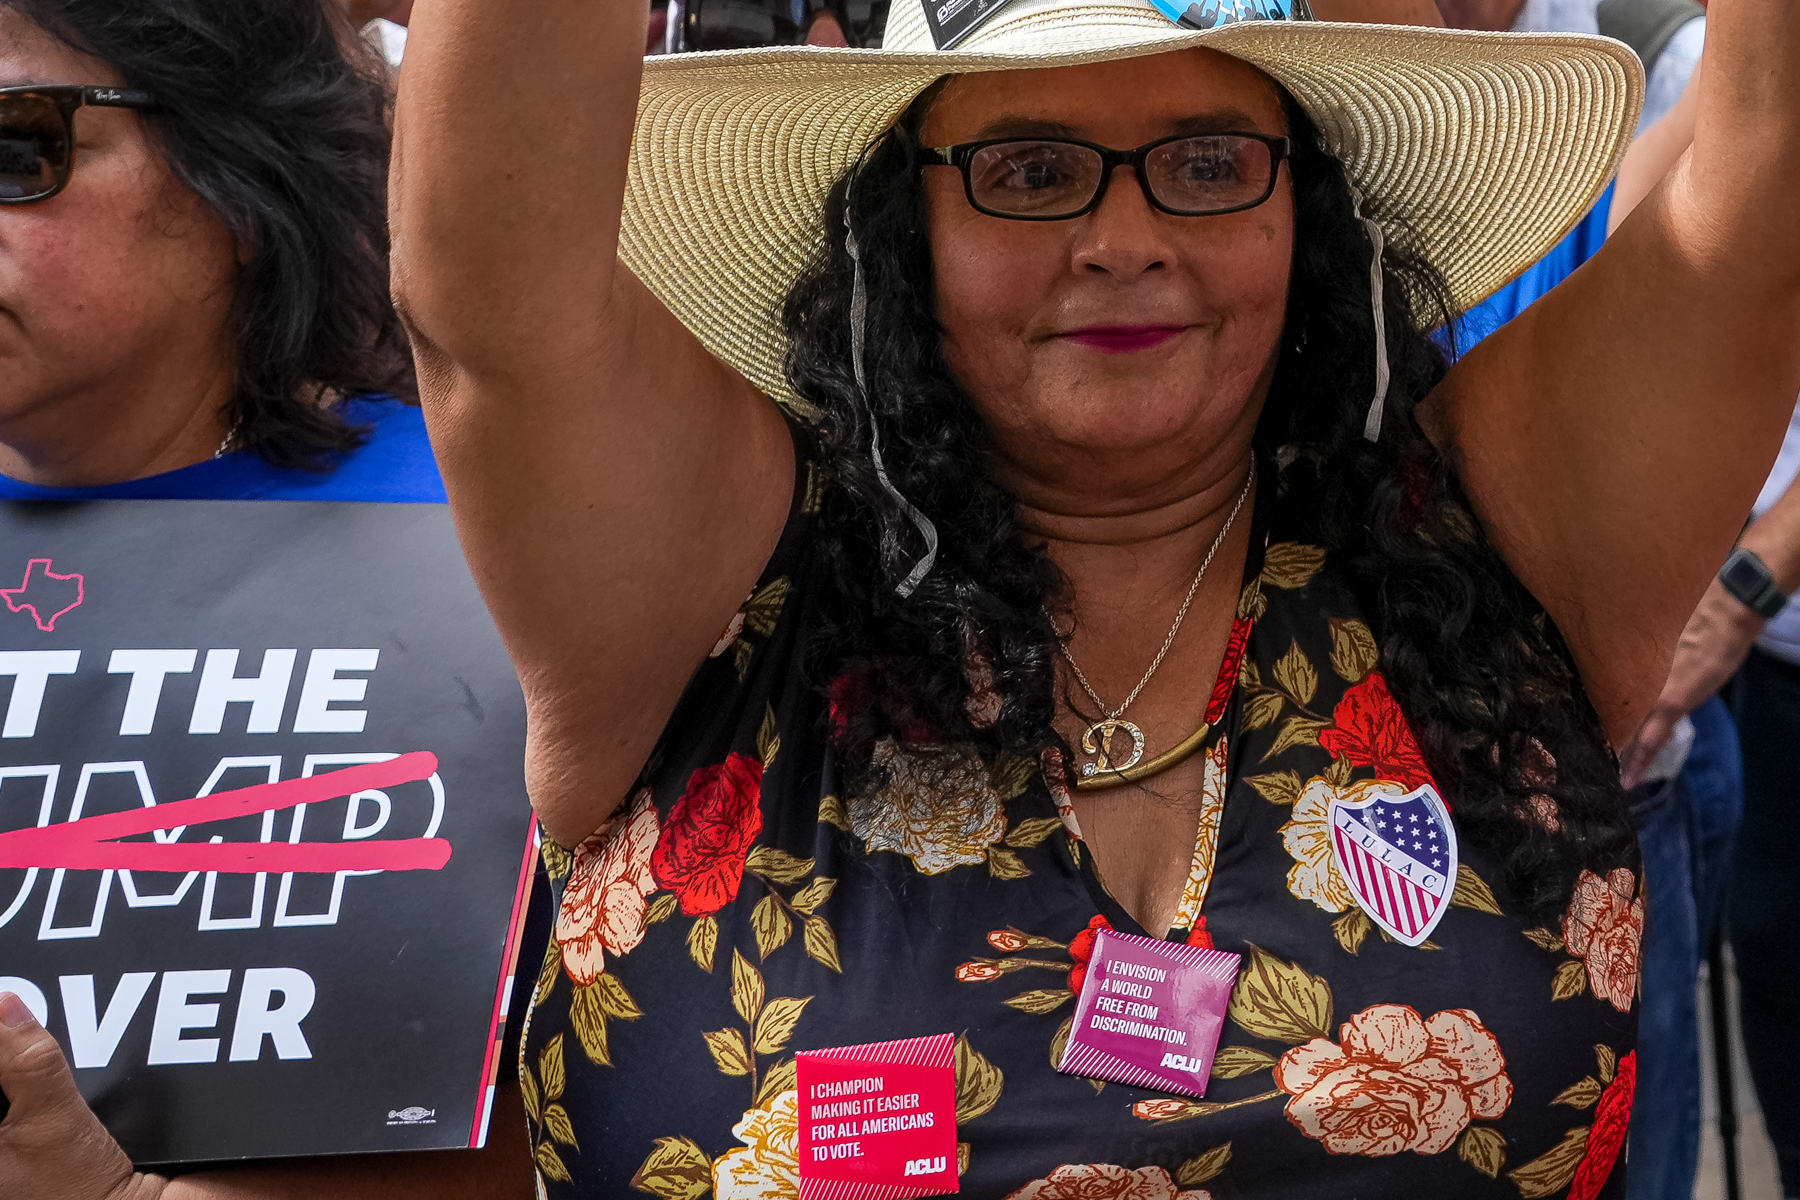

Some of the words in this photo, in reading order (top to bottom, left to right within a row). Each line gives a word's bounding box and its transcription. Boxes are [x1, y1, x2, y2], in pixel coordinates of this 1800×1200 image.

[107, 648, 381, 735] THE
[1342, 819, 1438, 889] LULAC
[1106, 960, 1112, 972] I
[1112, 960, 1167, 983] ENVISION
[1101, 978, 1110, 991] A
[1111, 980, 1153, 999] WORLD
[1095, 996, 1125, 1014] FREE
[1125, 1001, 1159, 1021] FROM
[1090, 1014, 1188, 1046] DISCRIMINATION.
[1160, 1052, 1202, 1073] ACLU
[811, 1084, 815, 1099] I
[817, 1077, 884, 1099] CHAMPION
[811, 1101, 861, 1120] MAKING
[863, 1099, 876, 1114] IT
[877, 1093, 920, 1112] EASIER
[811, 1124, 836, 1141] FOR
[837, 1121, 860, 1138] ALL
[861, 1112, 935, 1135] AMERICANS
[811, 1145, 828, 1162] TO
[830, 1142, 865, 1160] VOTE.
[904, 1156, 947, 1176] ACLU
